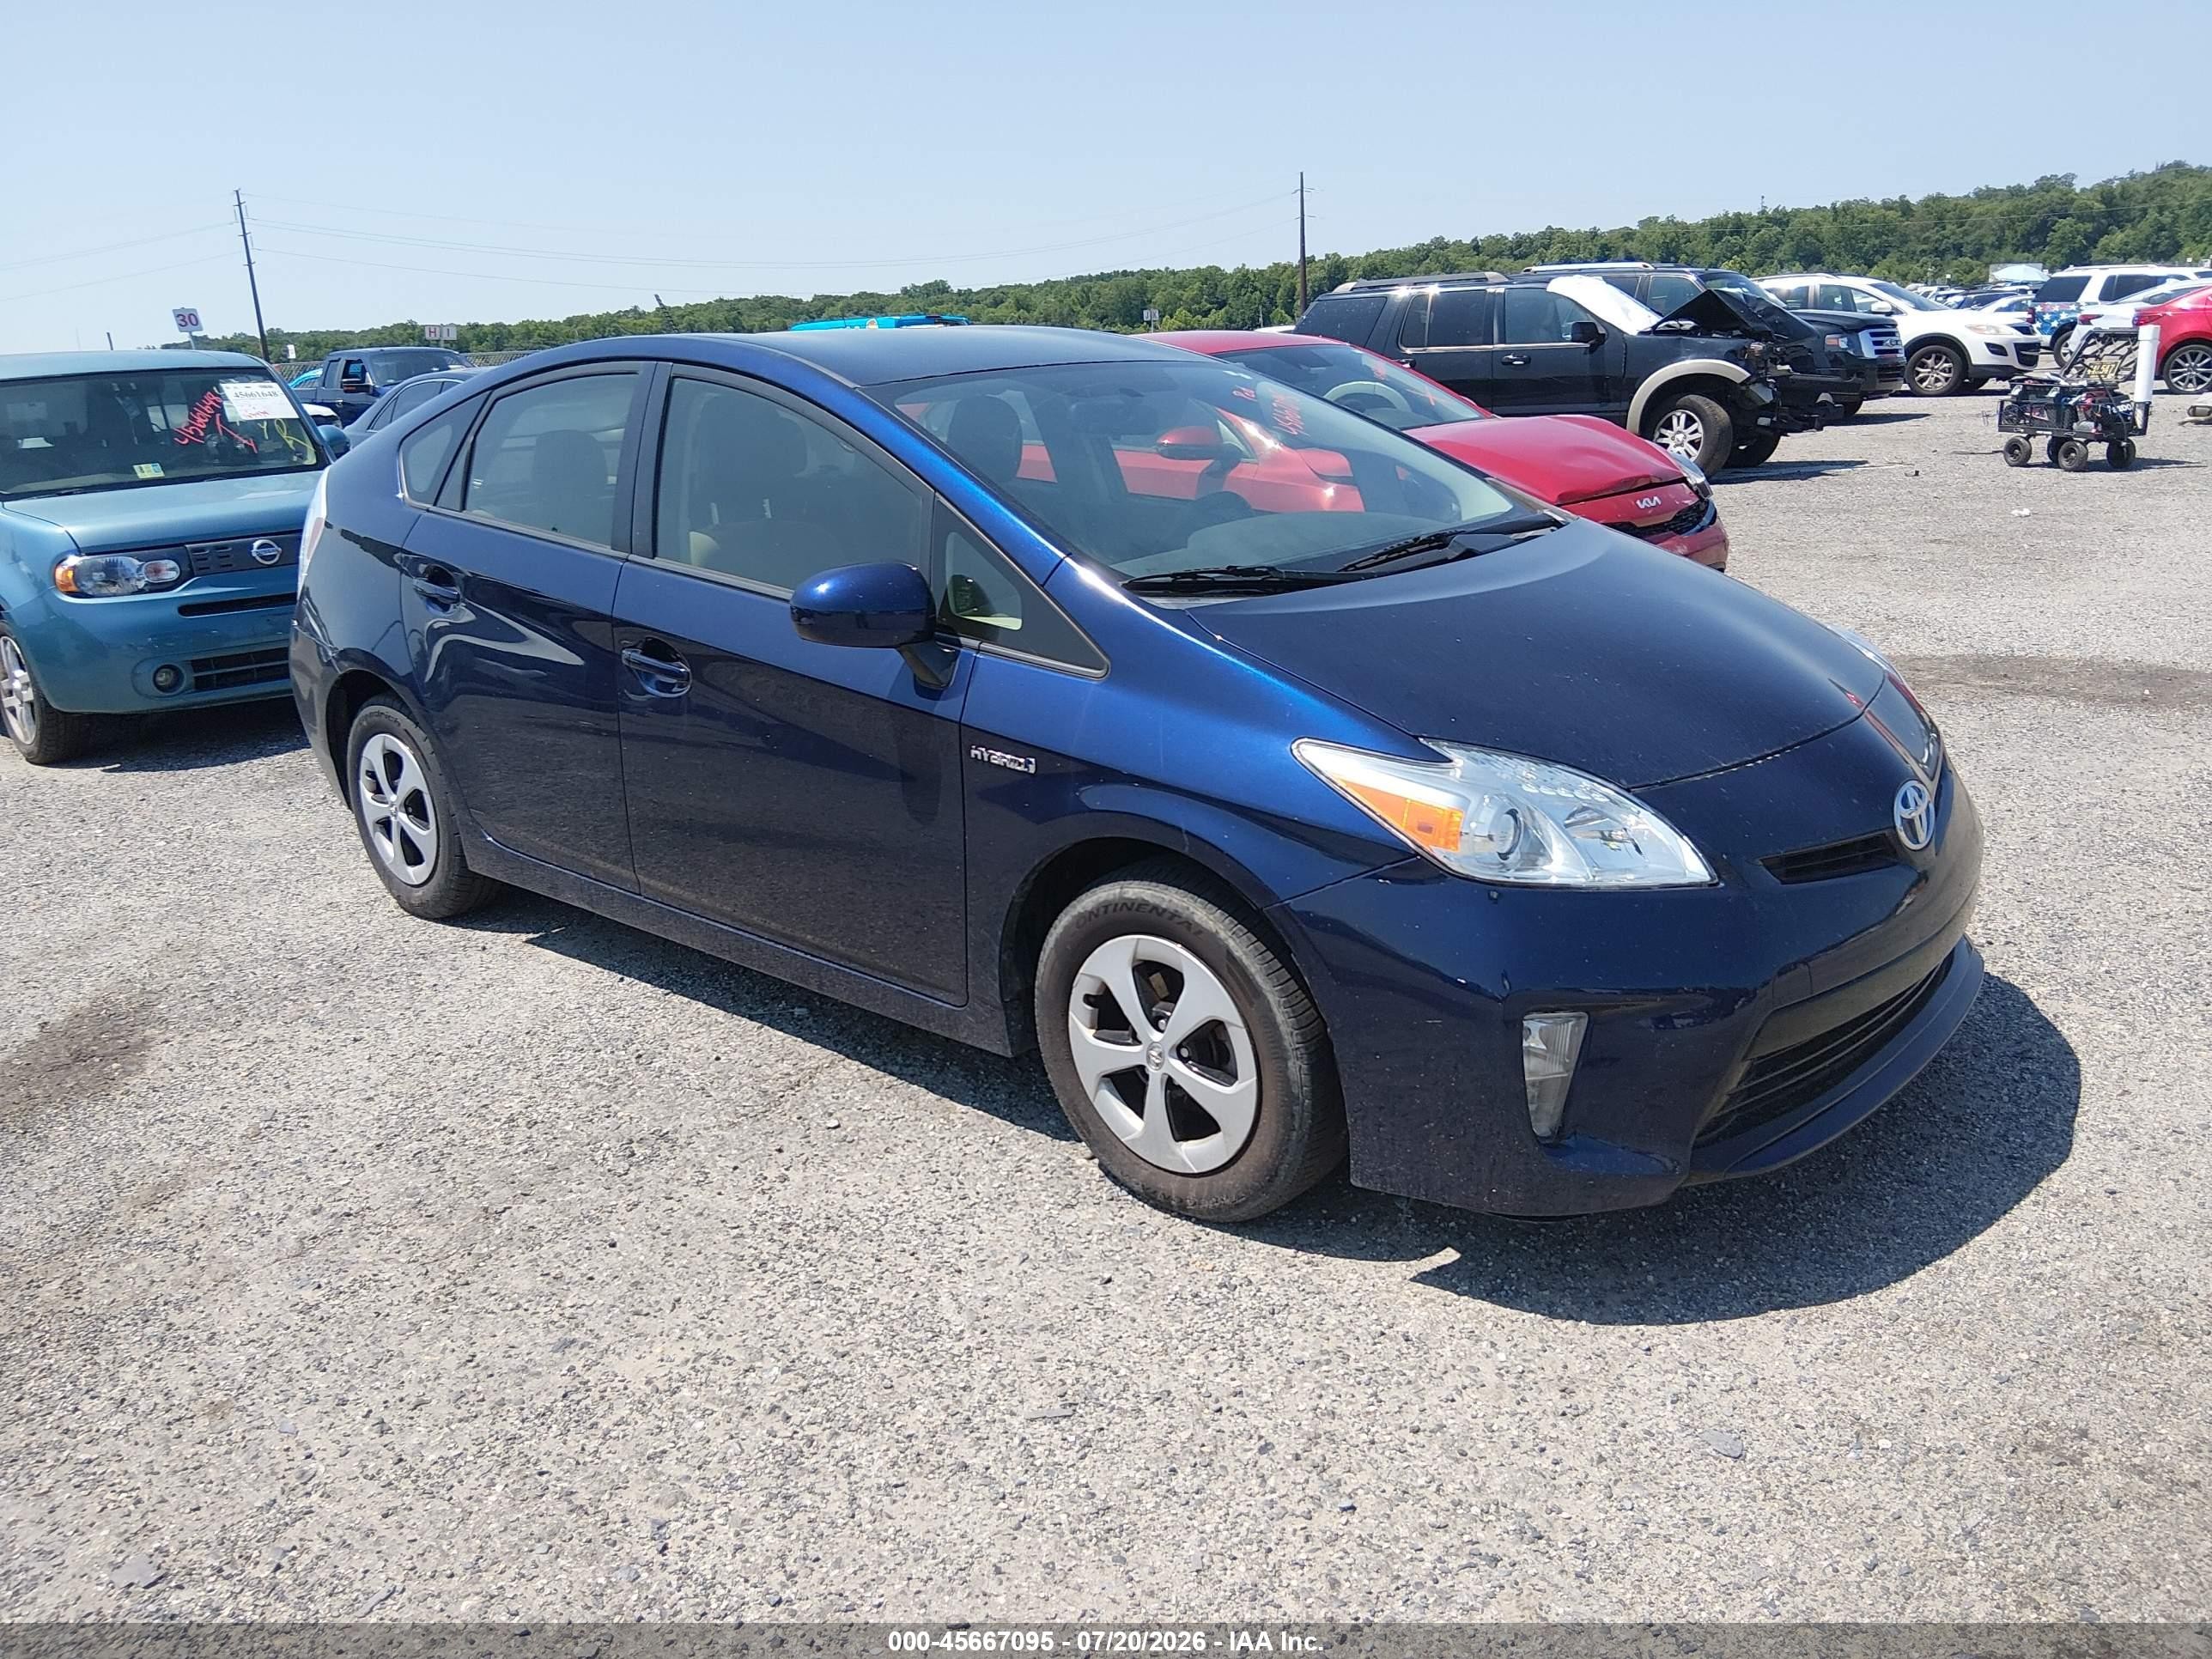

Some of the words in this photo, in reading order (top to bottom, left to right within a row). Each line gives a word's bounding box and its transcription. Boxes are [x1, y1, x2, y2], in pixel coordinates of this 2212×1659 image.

[176, 313, 198, 327] 30
[428, 327, 437, 337] H
[173, 391, 223, 446] 45661648
[1636, 495, 1662, 509] KIA
[969, 744, 1036, 775] HYBRID
[1072, 902, 1205, 940] ONTINENTAL
